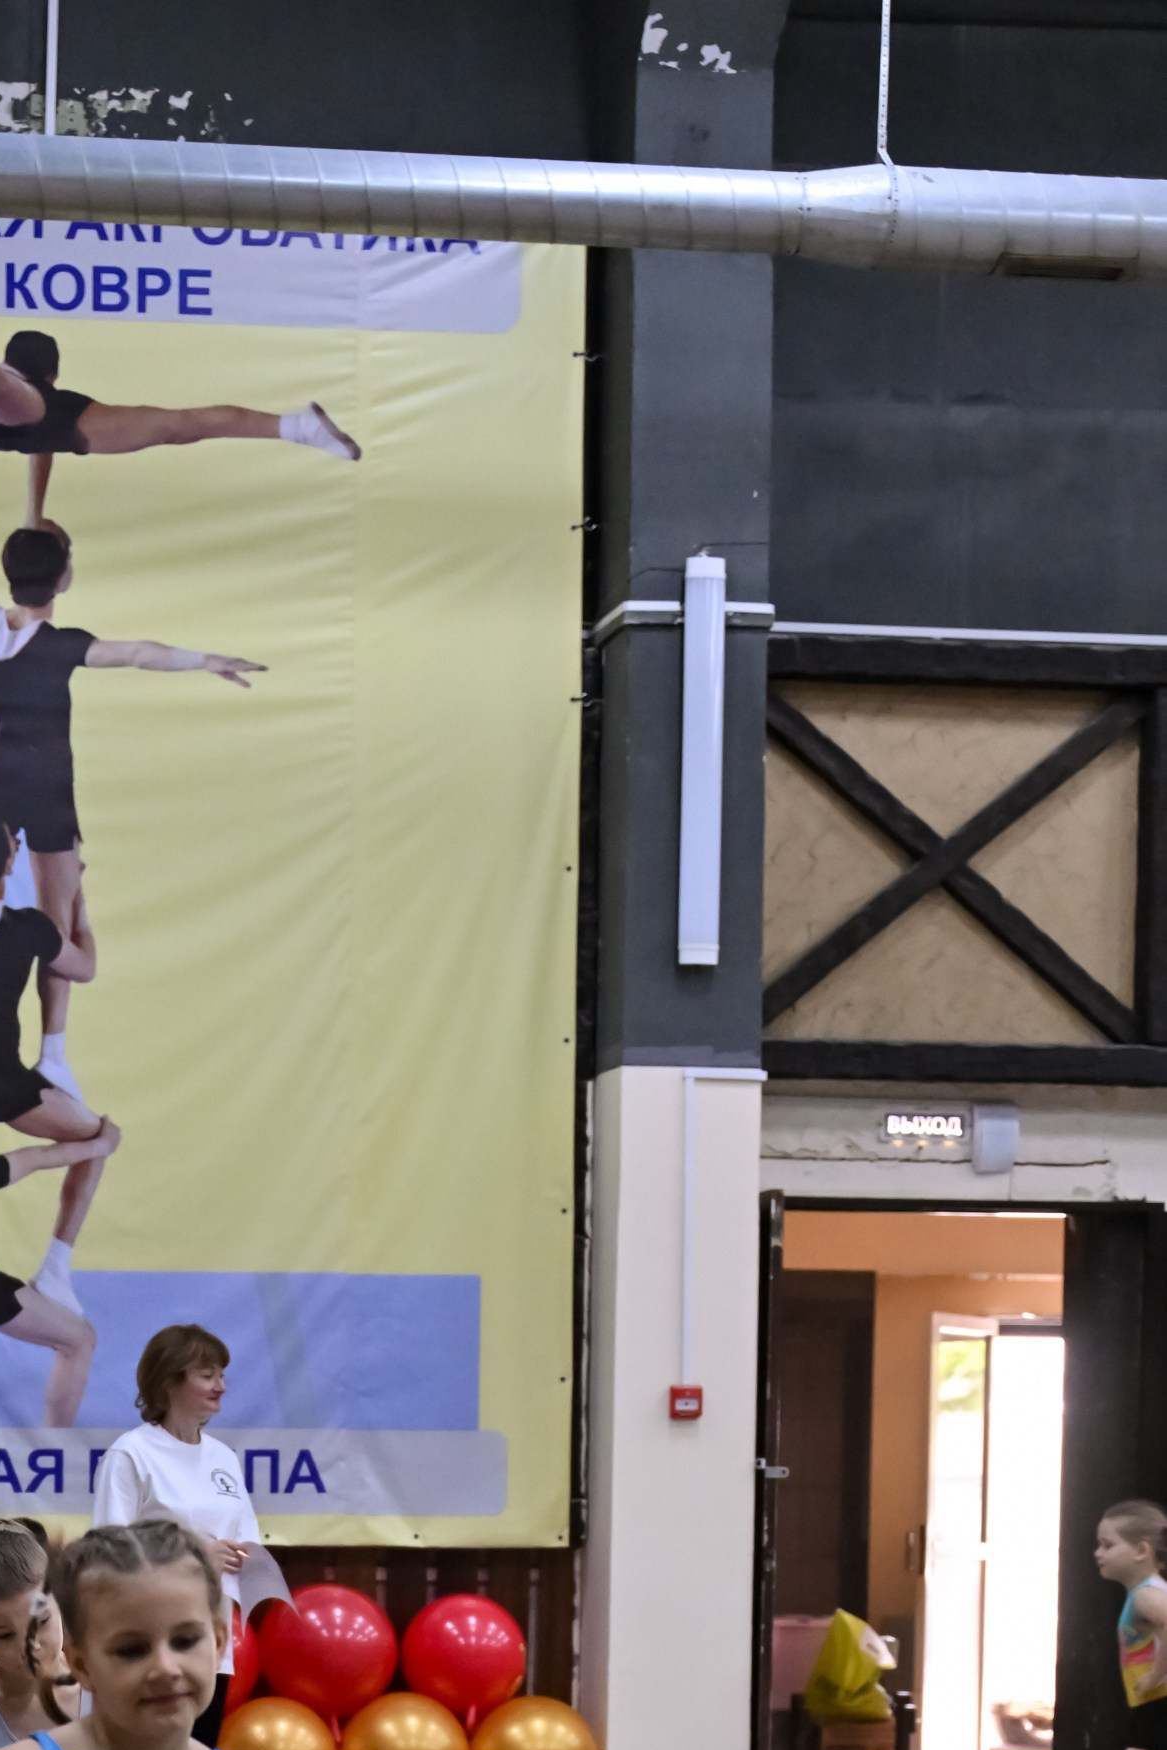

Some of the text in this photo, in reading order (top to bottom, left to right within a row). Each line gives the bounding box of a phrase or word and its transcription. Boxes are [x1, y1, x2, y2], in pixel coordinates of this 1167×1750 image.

[5, 262, 213, 316] КОВРЕ
[887, 1115, 963, 1136] ВЫХОД
[89, 1449, 327, 1493] ГПА
